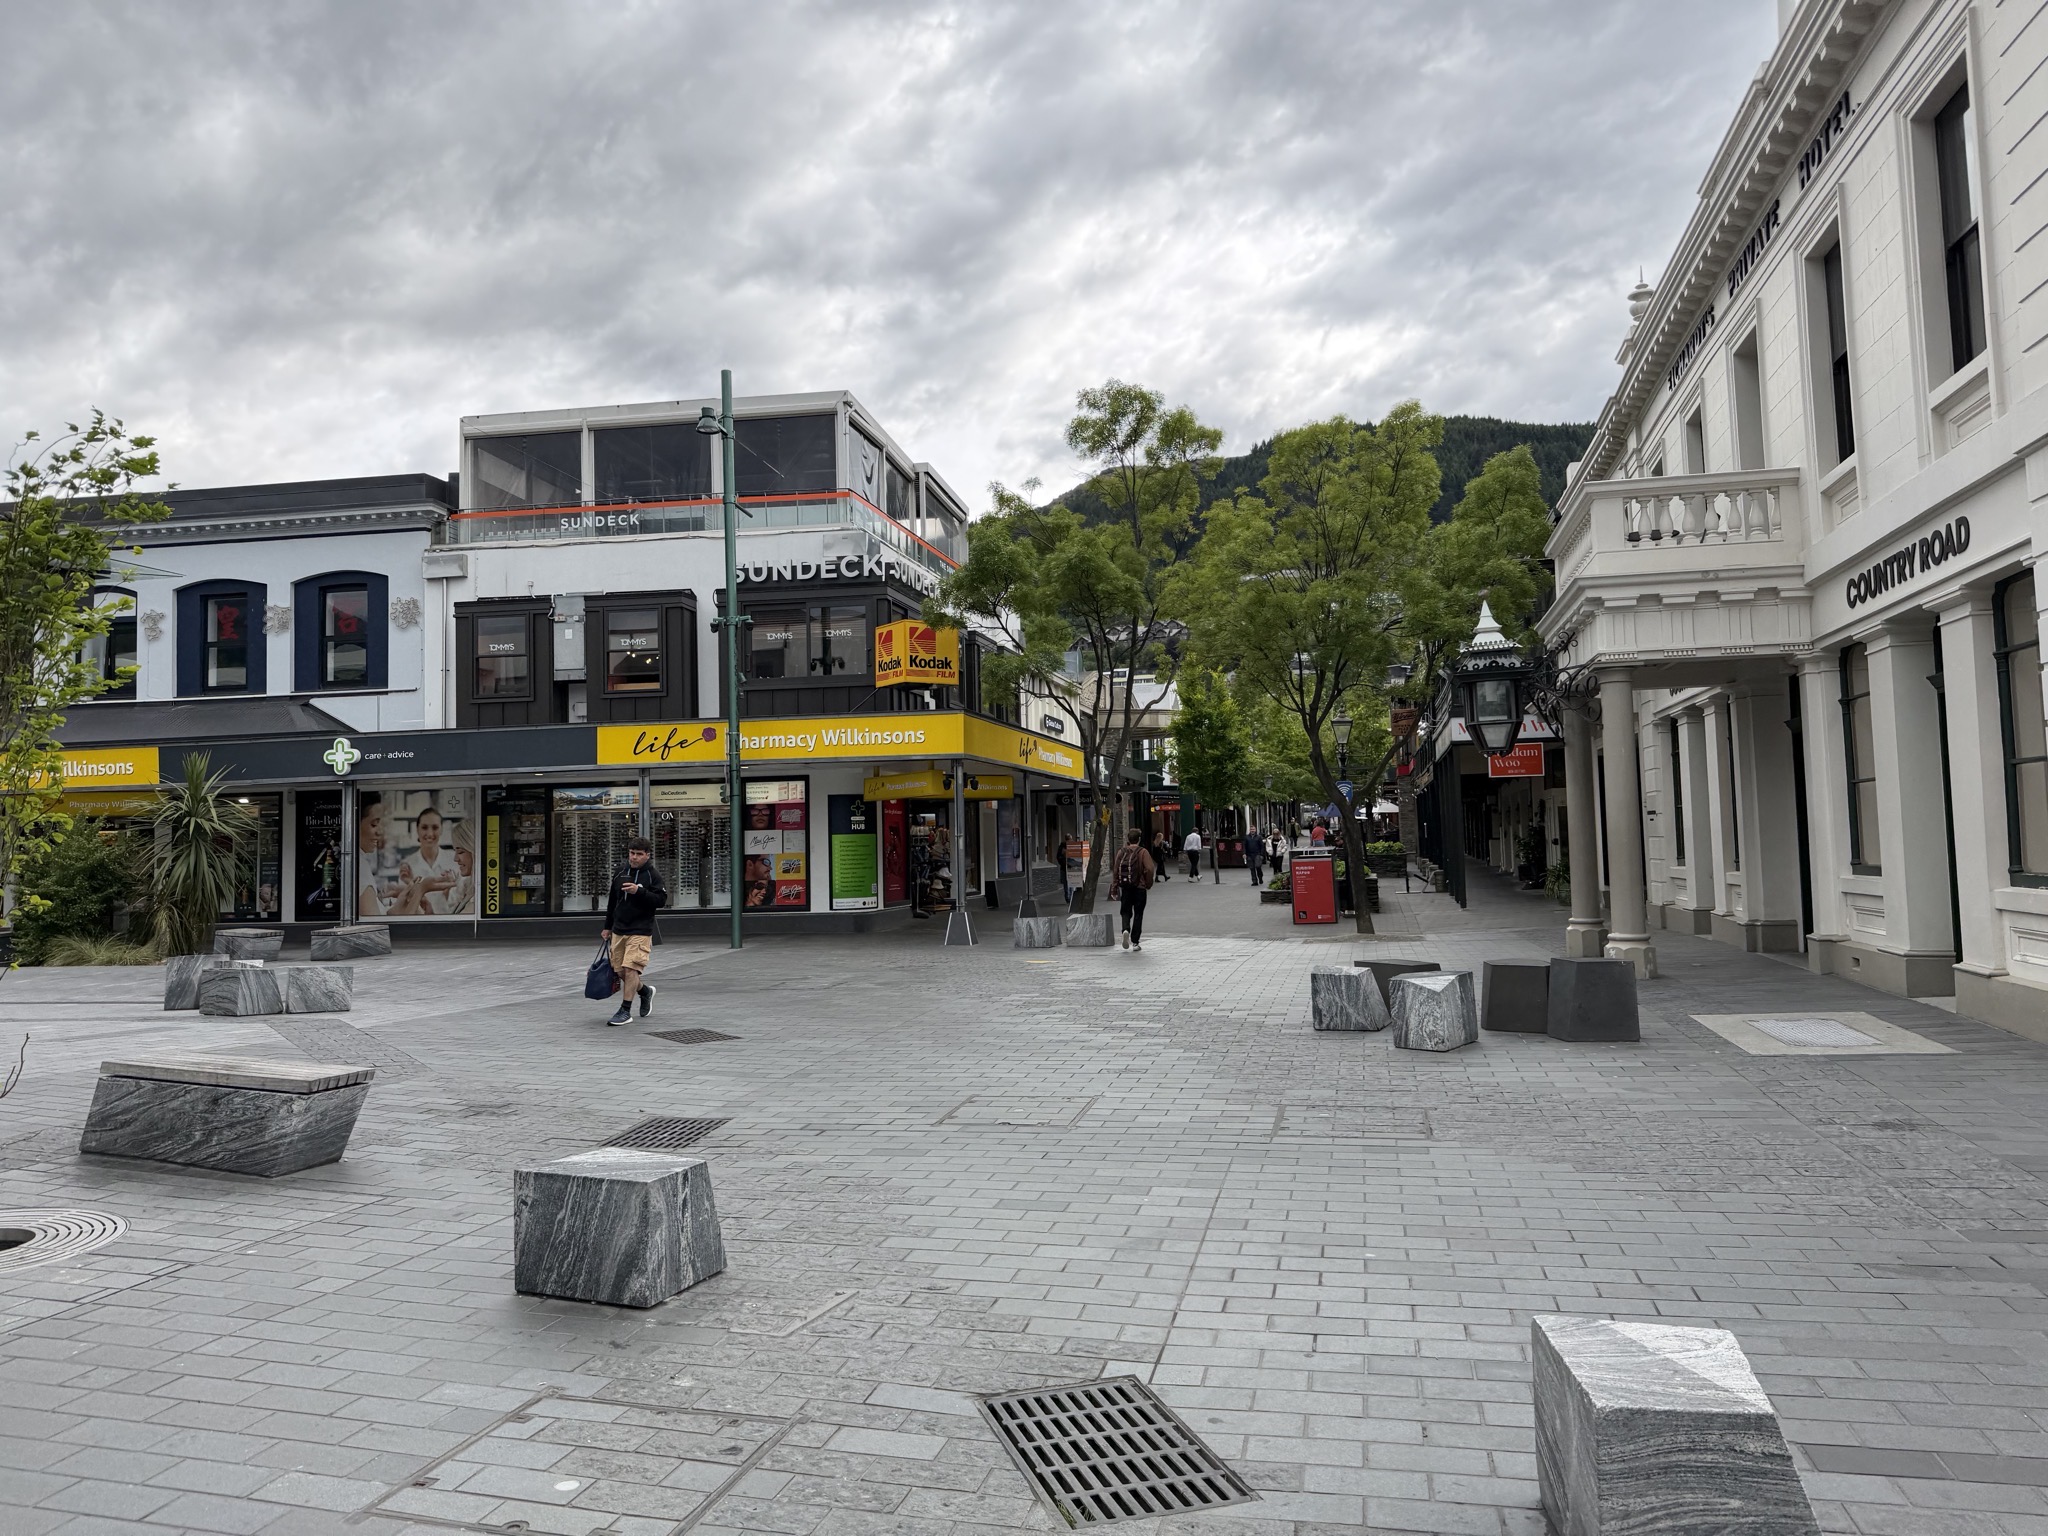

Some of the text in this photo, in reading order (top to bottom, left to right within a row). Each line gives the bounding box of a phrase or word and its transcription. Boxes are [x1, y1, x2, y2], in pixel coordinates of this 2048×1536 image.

[1727, 199, 1781, 299] PRIVATE
[1797, 90, 1861, 192] HOTEL
[561, 514, 640, 529] SUNDECK
[736, 553, 883, 584] SUNDECK
[1846, 516, 1970, 609] COUNTRY ROAD
[878, 655, 902, 673] Kodak
[909, 655, 952, 670] Kodak
[892, 669, 903, 678] FILM
[936, 670, 956, 679] FILM
[633, 728, 703, 761] life
[739, 727, 926, 752] harmacy Wilkinsons
[387, 750, 414, 759] advice
[1019, 737, 1036, 764] life
[51, 761, 134, 778] ilkinsons
[1494, 759, 1521, 768] Woo
[69, 801, 110, 809] Pharmacy
